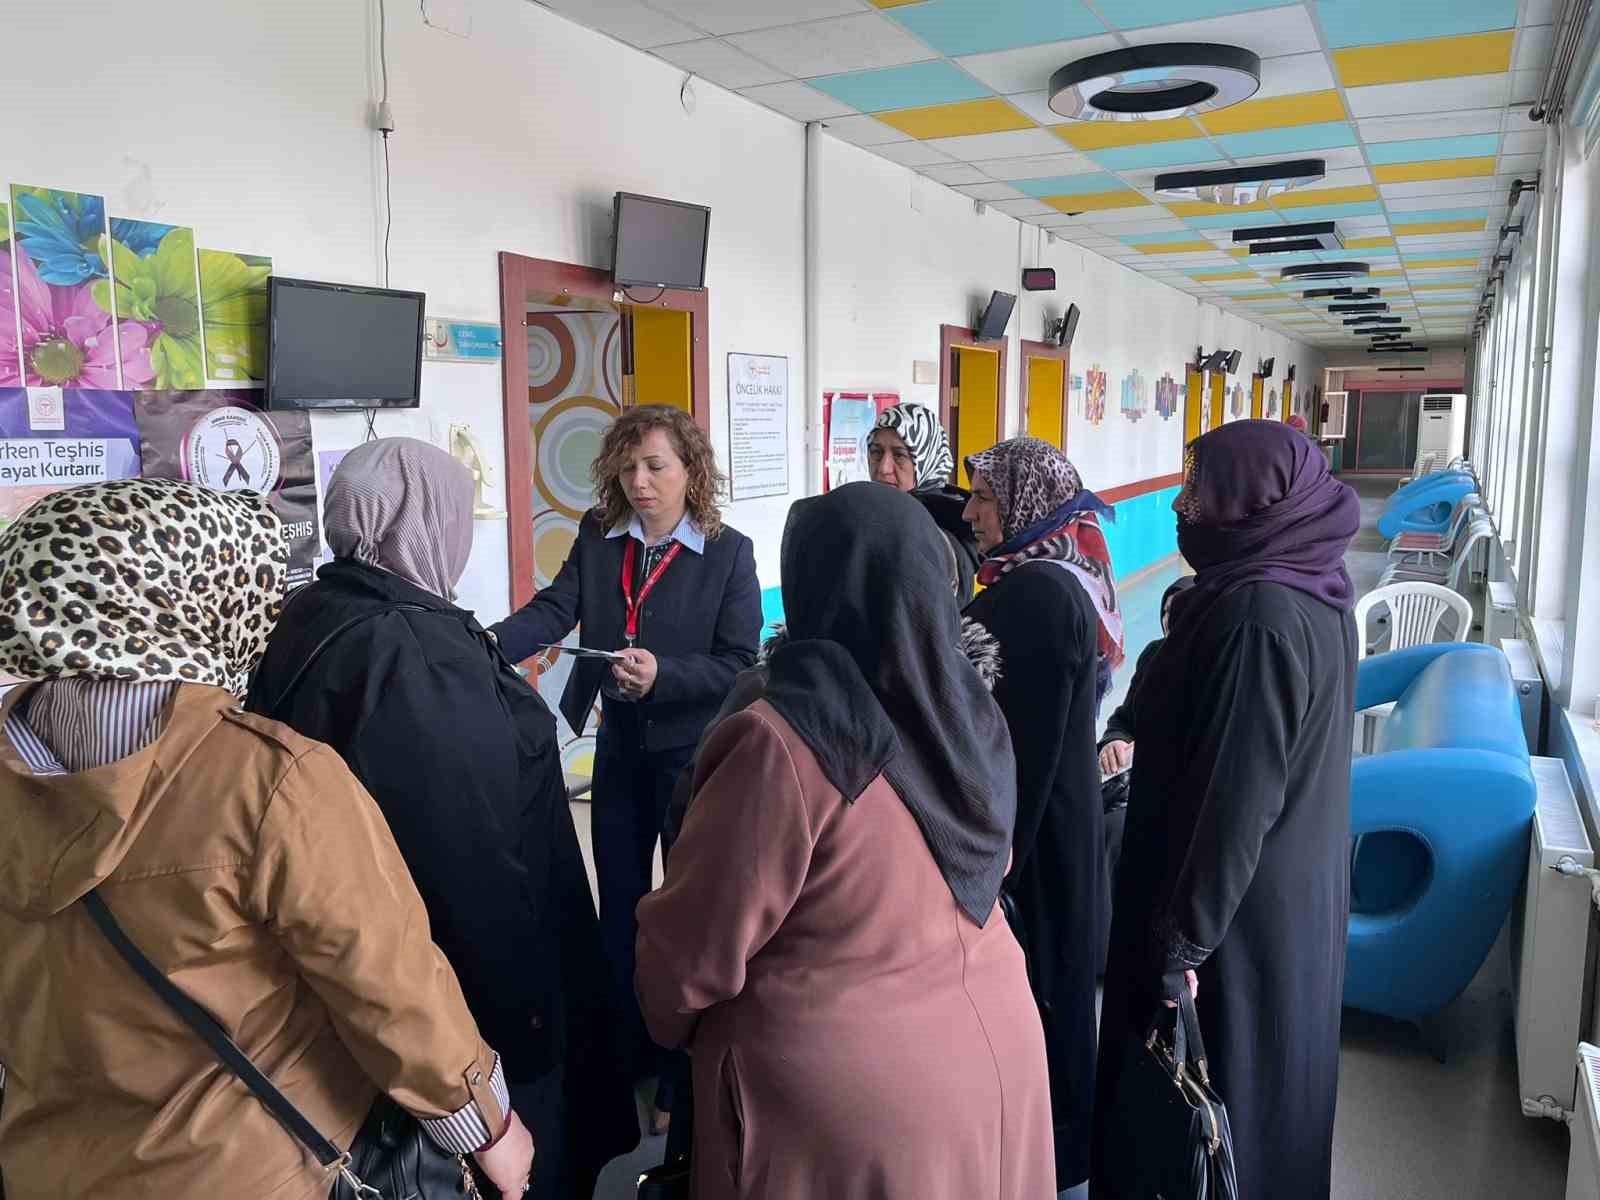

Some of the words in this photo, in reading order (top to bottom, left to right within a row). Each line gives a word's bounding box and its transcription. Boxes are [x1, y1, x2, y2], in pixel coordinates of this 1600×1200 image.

[0, 442, 39, 459] rken
[43, 441, 104, 462] Teşhis
[0, 465, 37, 482] ayat
[40, 462, 104, 477] Kurtarır.
